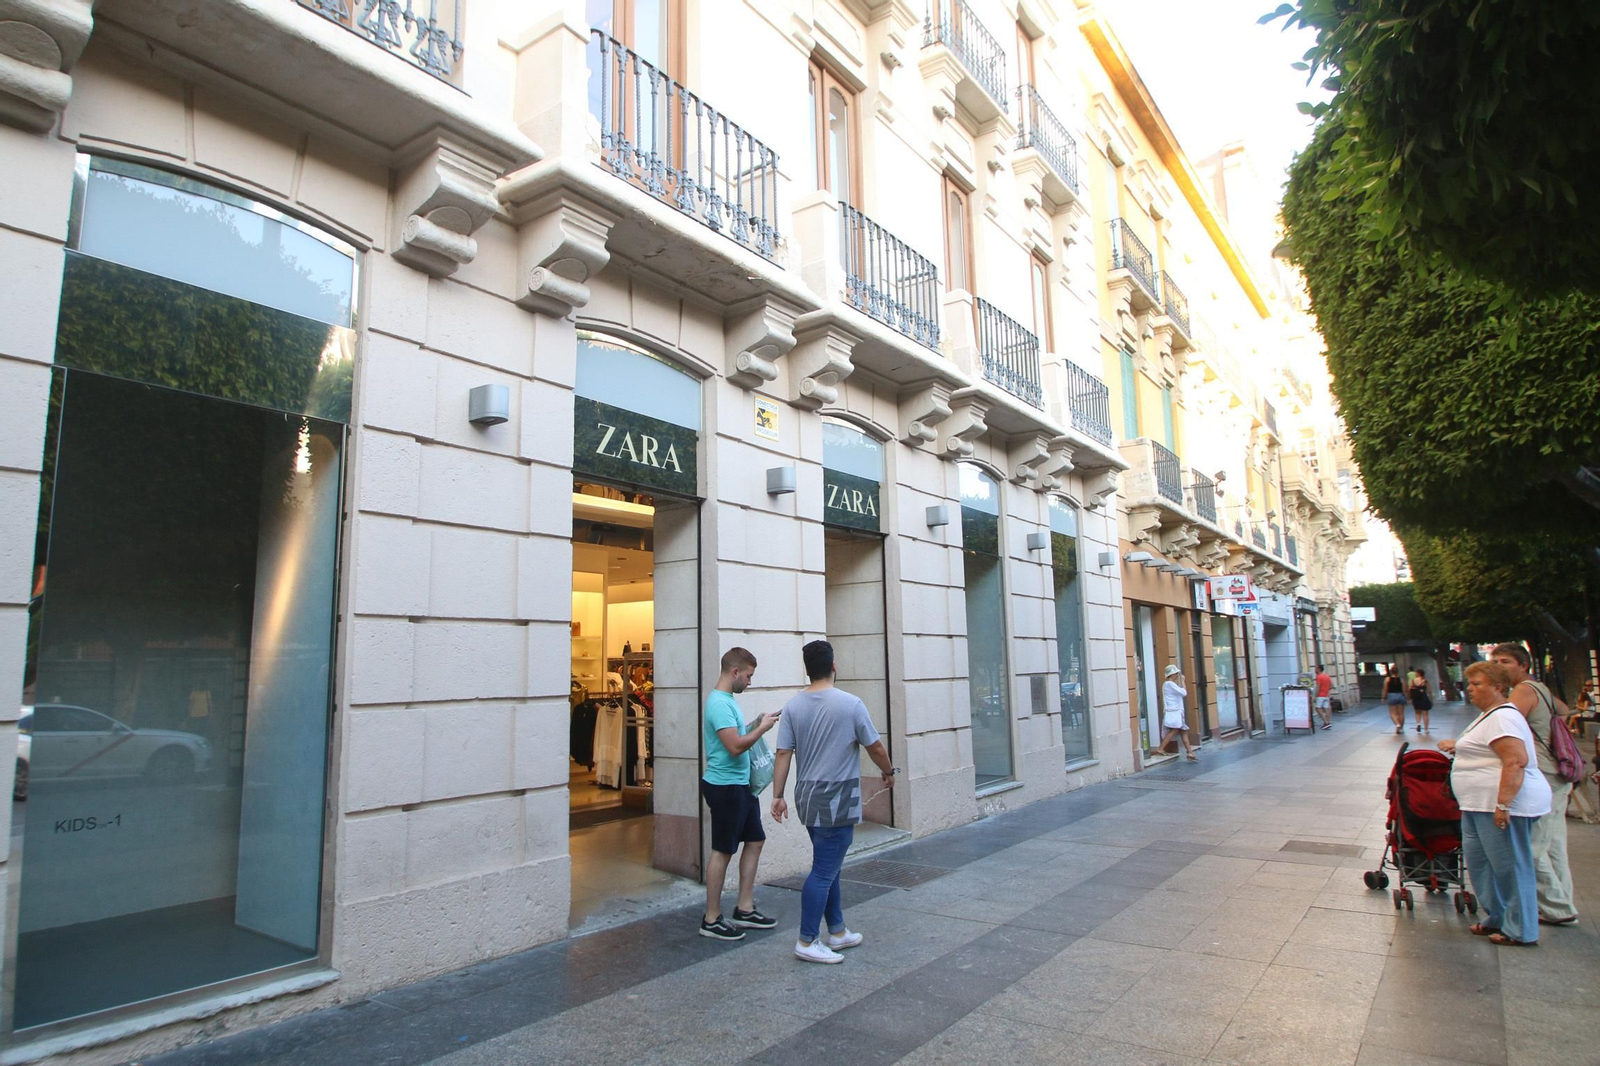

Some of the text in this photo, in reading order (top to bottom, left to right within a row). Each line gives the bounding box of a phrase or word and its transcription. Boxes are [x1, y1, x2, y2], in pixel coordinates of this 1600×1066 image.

[596, 423, 683, 473] ZARA
[827, 483, 877, 517] ZARA
[54, 816, 97, 833] KIDS
